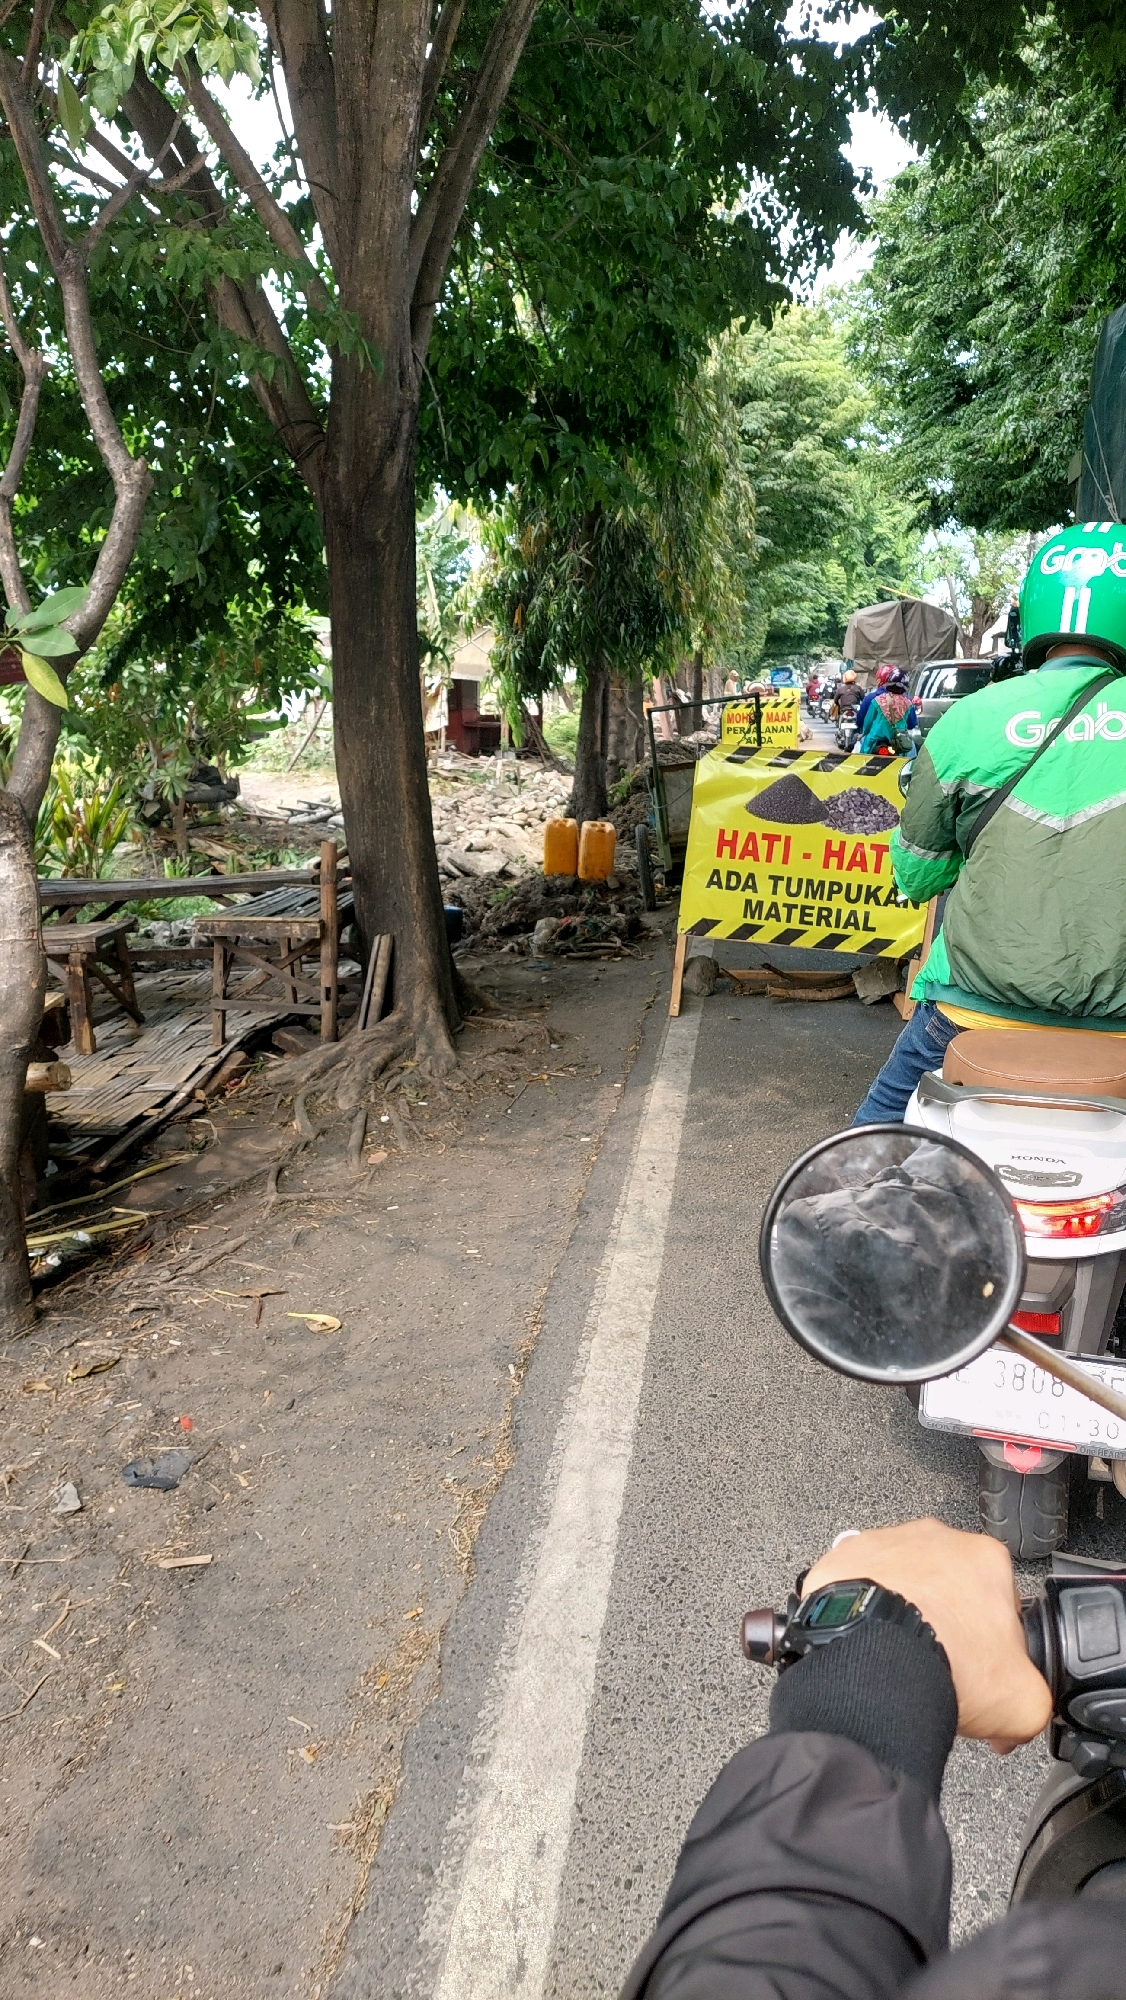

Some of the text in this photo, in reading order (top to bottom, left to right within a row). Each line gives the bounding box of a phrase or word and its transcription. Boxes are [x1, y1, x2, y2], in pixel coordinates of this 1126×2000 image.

[1040, 541, 1126, 577] Grab
[727, 711, 793, 724] MOHO MAAF
[1005, 702, 1126, 748] Grab
[726, 725, 793, 735] PERJAANAN
[715, 828, 792, 865] HATI
[822, 839, 894, 876] HAT
[706, 868, 759, 894] ADA
[742, 899, 877, 932] MATERIAL
[1011, 1155, 1067, 1164] HONDA
[926, 1421, 969, 1434] HONDA
[1079, 1445, 1125, 1459] One HEART
